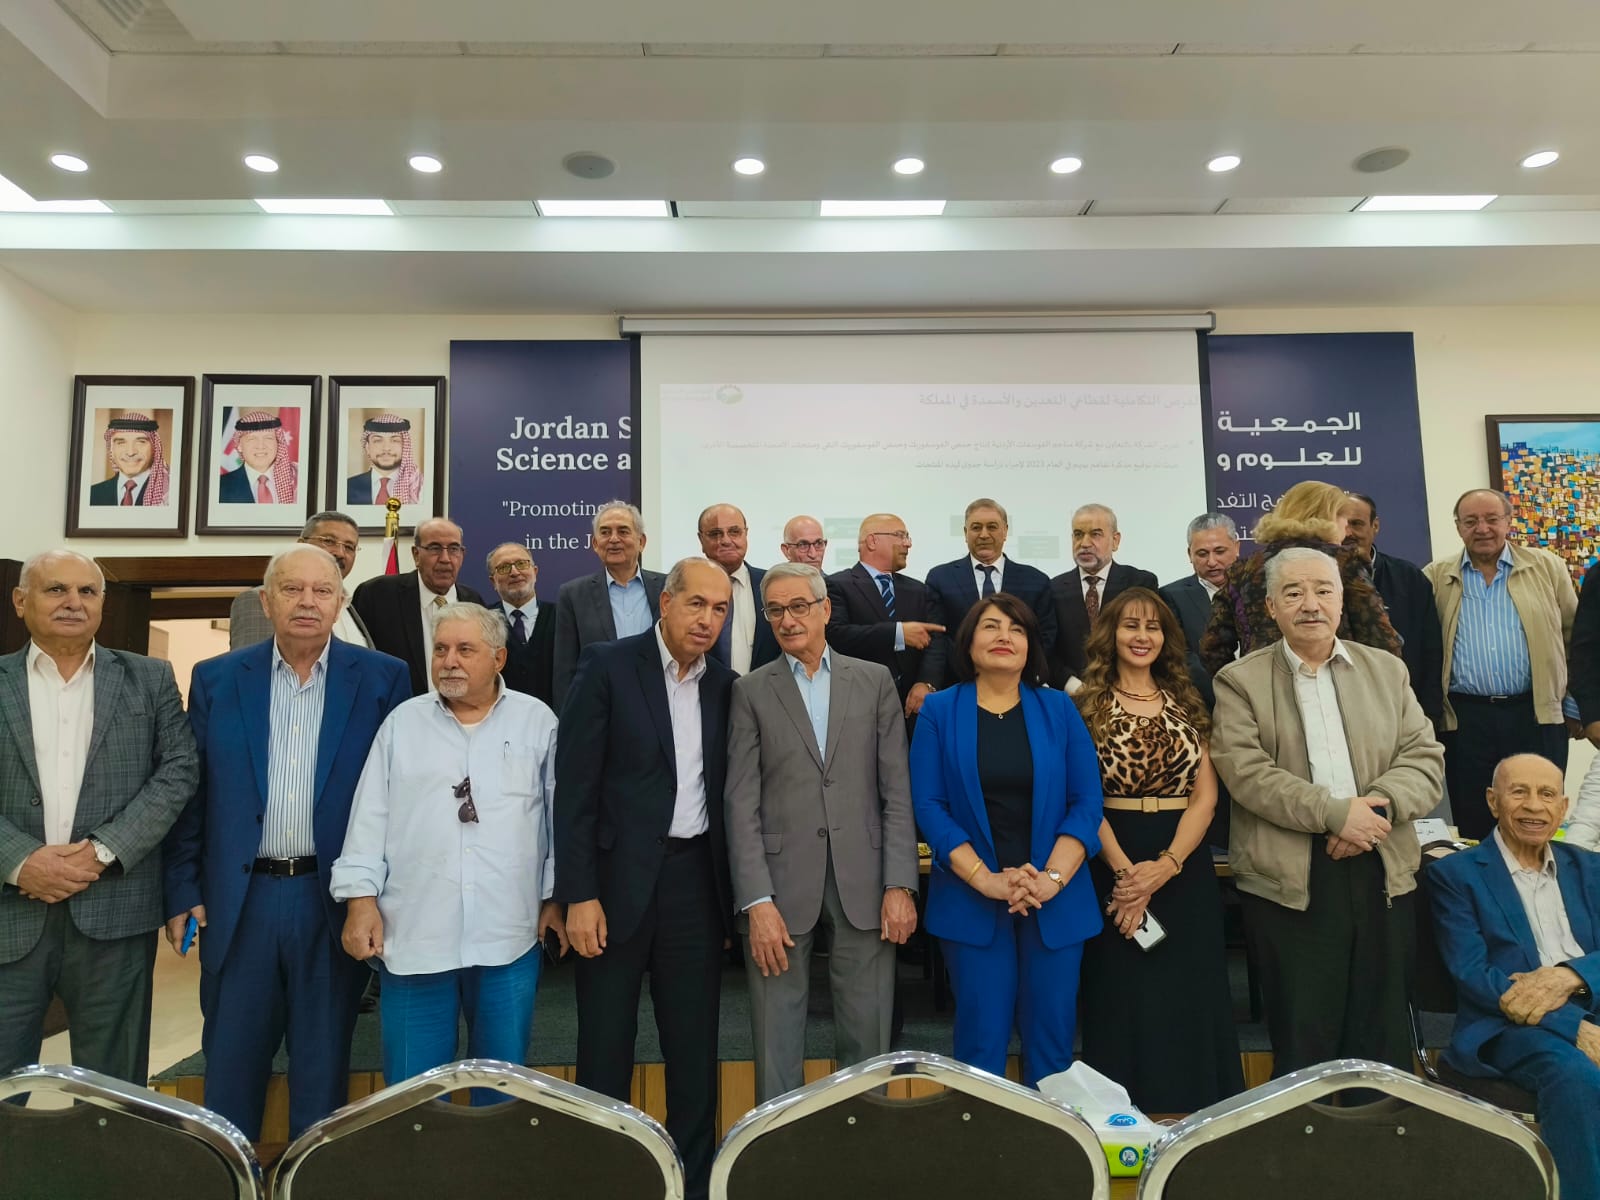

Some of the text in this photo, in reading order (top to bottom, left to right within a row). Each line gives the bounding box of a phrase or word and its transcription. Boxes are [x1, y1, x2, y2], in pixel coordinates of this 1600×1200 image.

[510, 415, 632, 440] Jordan S
[1217, 410, 1361, 436] الجمعية
[496, 446, 632, 471] Science a
[1216, 446, 1362, 472] للعلوم و
[525, 533, 593, 550] in the J
